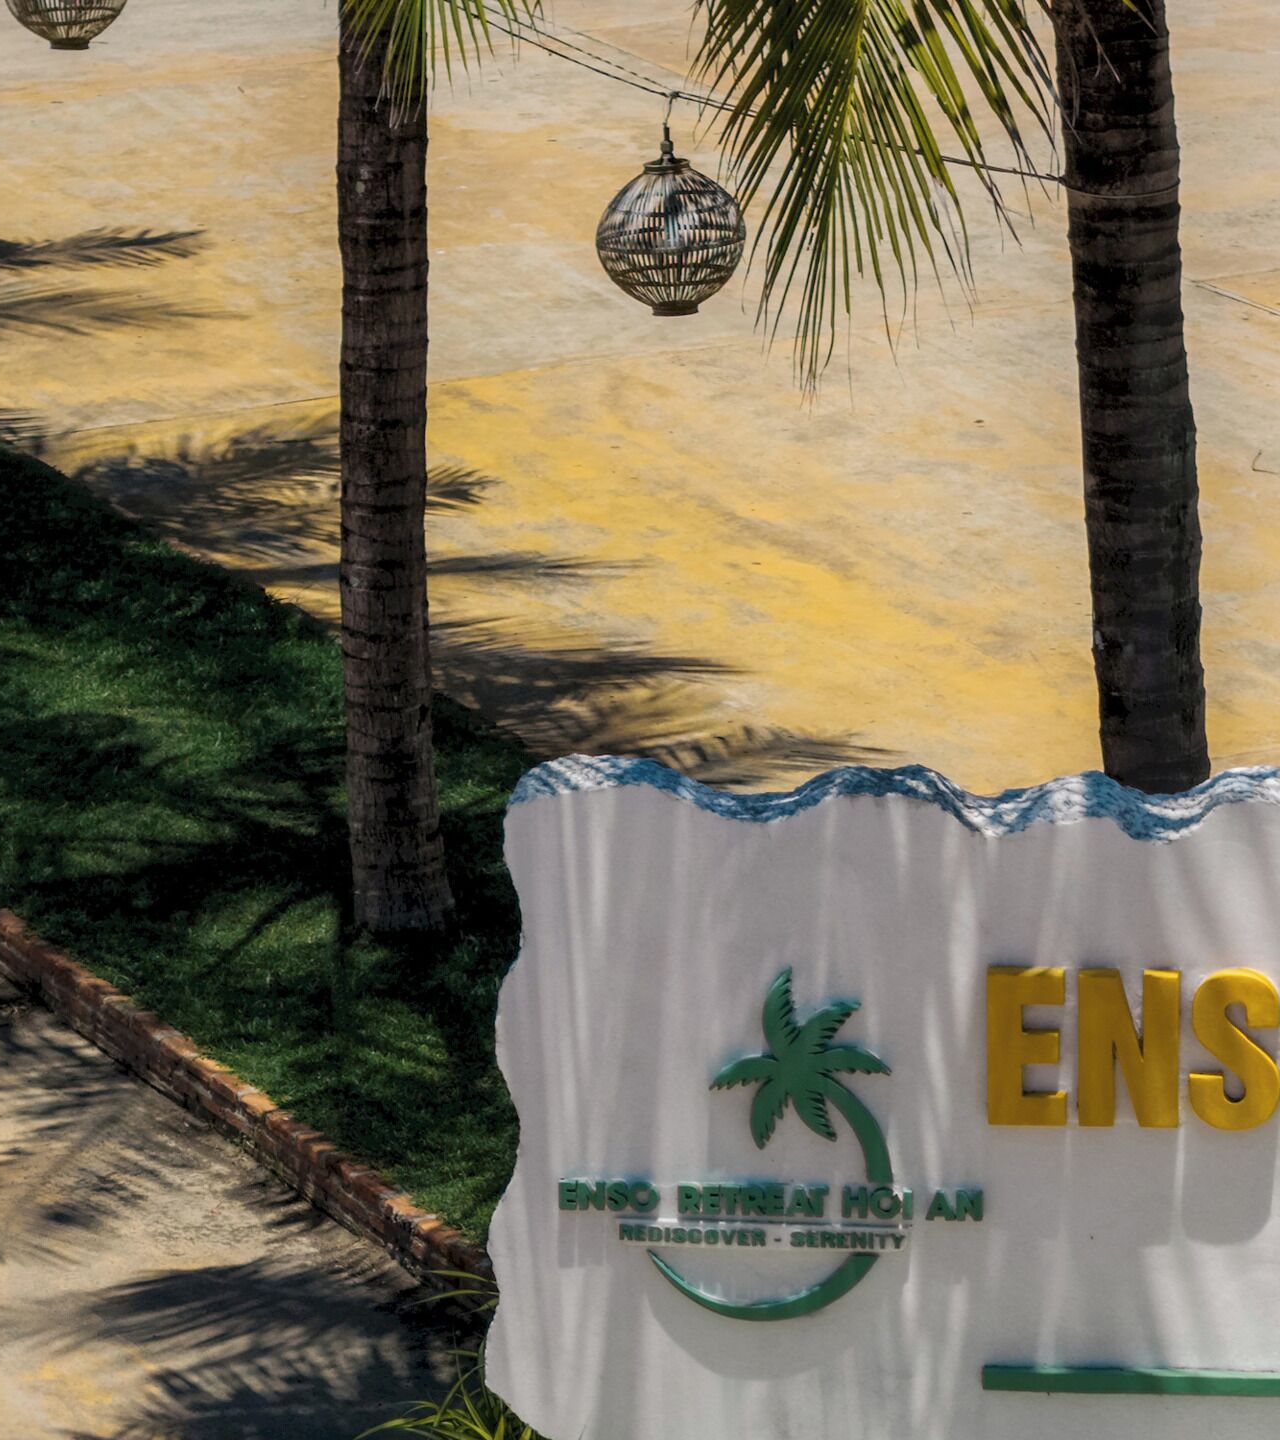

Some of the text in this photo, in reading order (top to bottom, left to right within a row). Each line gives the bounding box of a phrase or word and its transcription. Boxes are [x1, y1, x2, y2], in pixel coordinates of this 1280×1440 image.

[558, 1180, 984, 1222] ENSO RETREAT HOI AN
[619, 1223, 766, 1248] REDISCOVER
[790, 1230, 906, 1250] SERENITY
